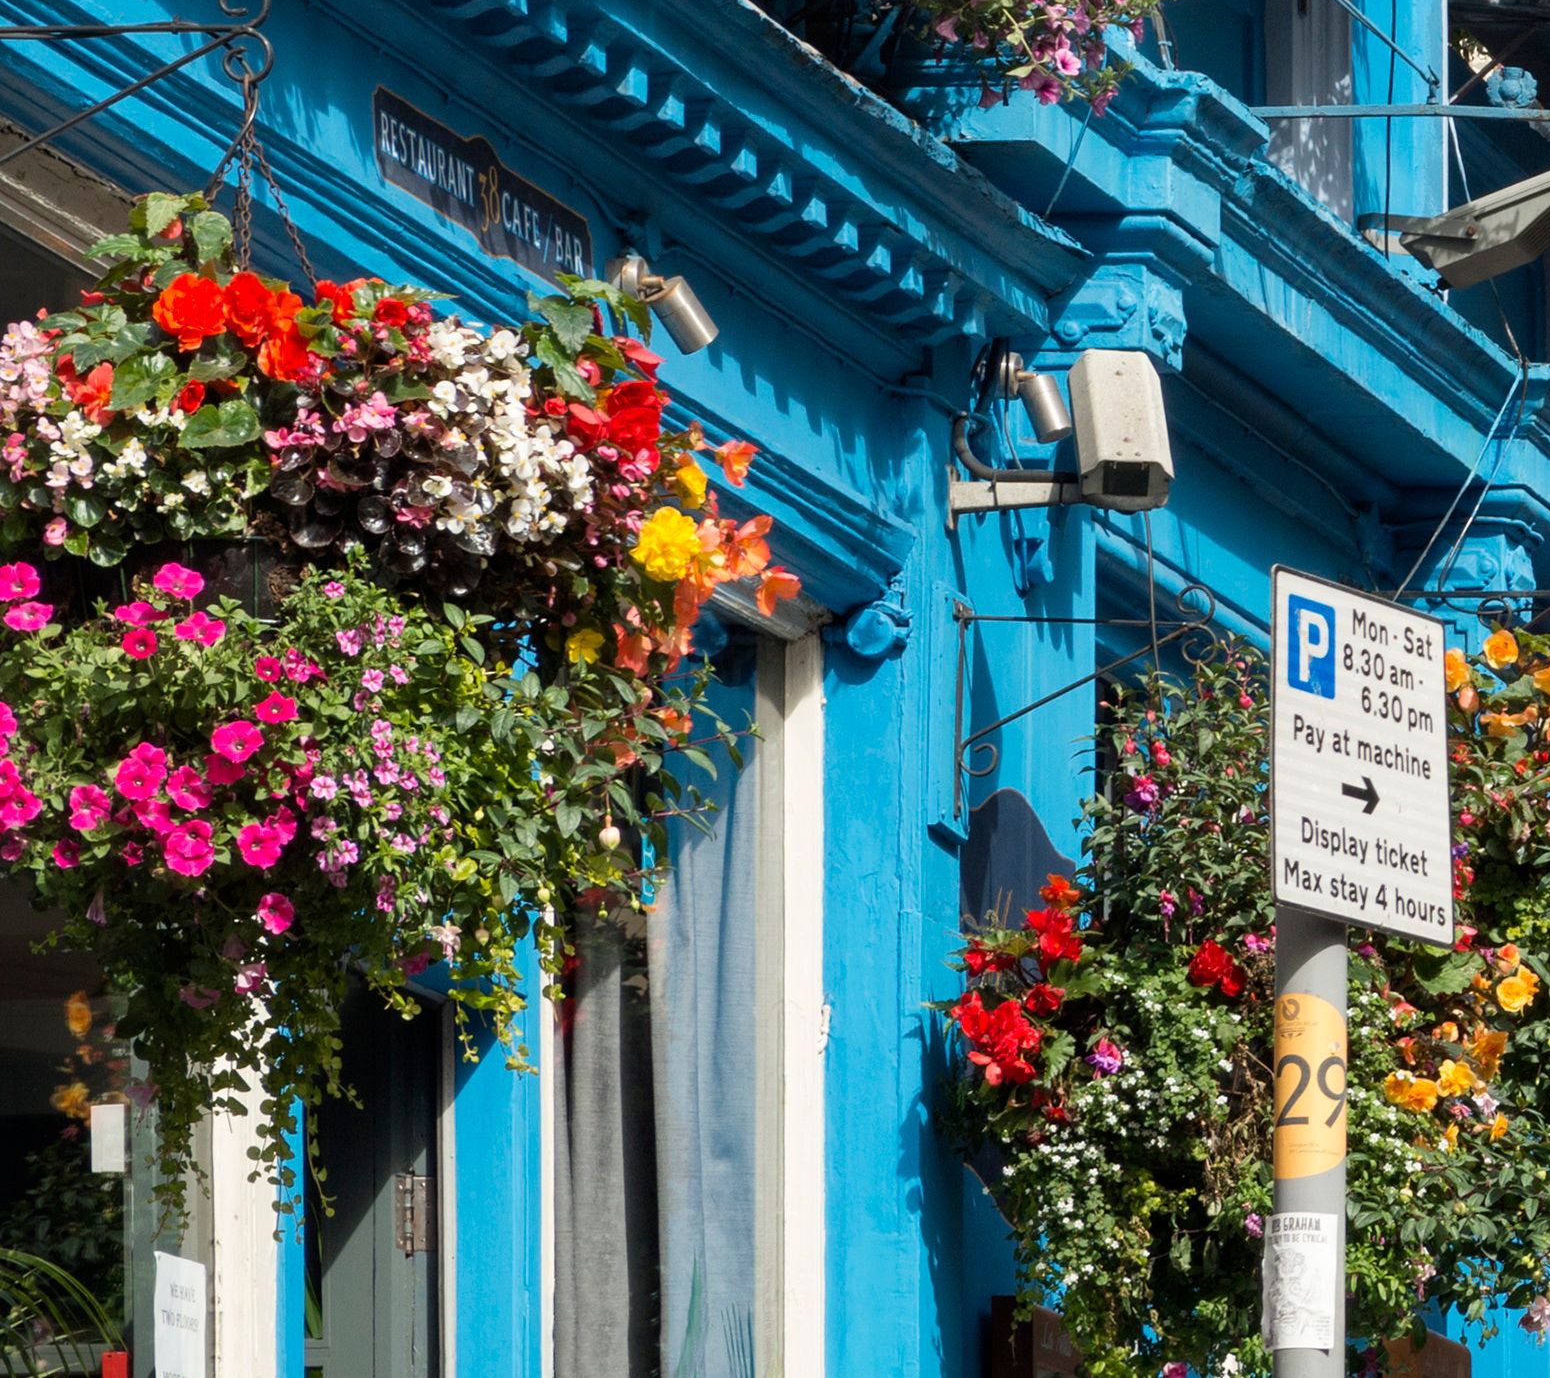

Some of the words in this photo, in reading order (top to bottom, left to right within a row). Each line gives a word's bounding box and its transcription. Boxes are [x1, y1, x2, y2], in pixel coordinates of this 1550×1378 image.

[380, 112, 475, 208] RESTAURANT
[479, 166, 500, 232] 38
[502, 193, 541, 250] CAFE
[554, 224, 585, 278] BAR
[1295, 609, 1329, 682] P
[1352, 609, 1388, 645] Mon
[1403, 627, 1433, 661] Sat
[1343, 643, 1385, 681] 8.30
[1390, 665, 1414, 690] am
[1361, 686, 1403, 723] 6.30
[1408, 708, 1433, 733] pm
[1294, 714, 1325, 753] Pay
[1333, 729, 1350, 756] at
[1358, 739, 1431, 780] machine
[1301, 816, 1368, 864] Display
[1376, 837, 1428, 876] ticket
[1284, 858, 1323, 894] Max
[1330, 874, 1368, 910] stay
[1375, 884, 1388, 910] 4
[1395, 887, 1446, 926] hours
[1275, 1054, 1346, 1128] 29
[1283, 1217, 1321, 1232] GRAHAM
[161, 1309, 175, 1327] TWO
